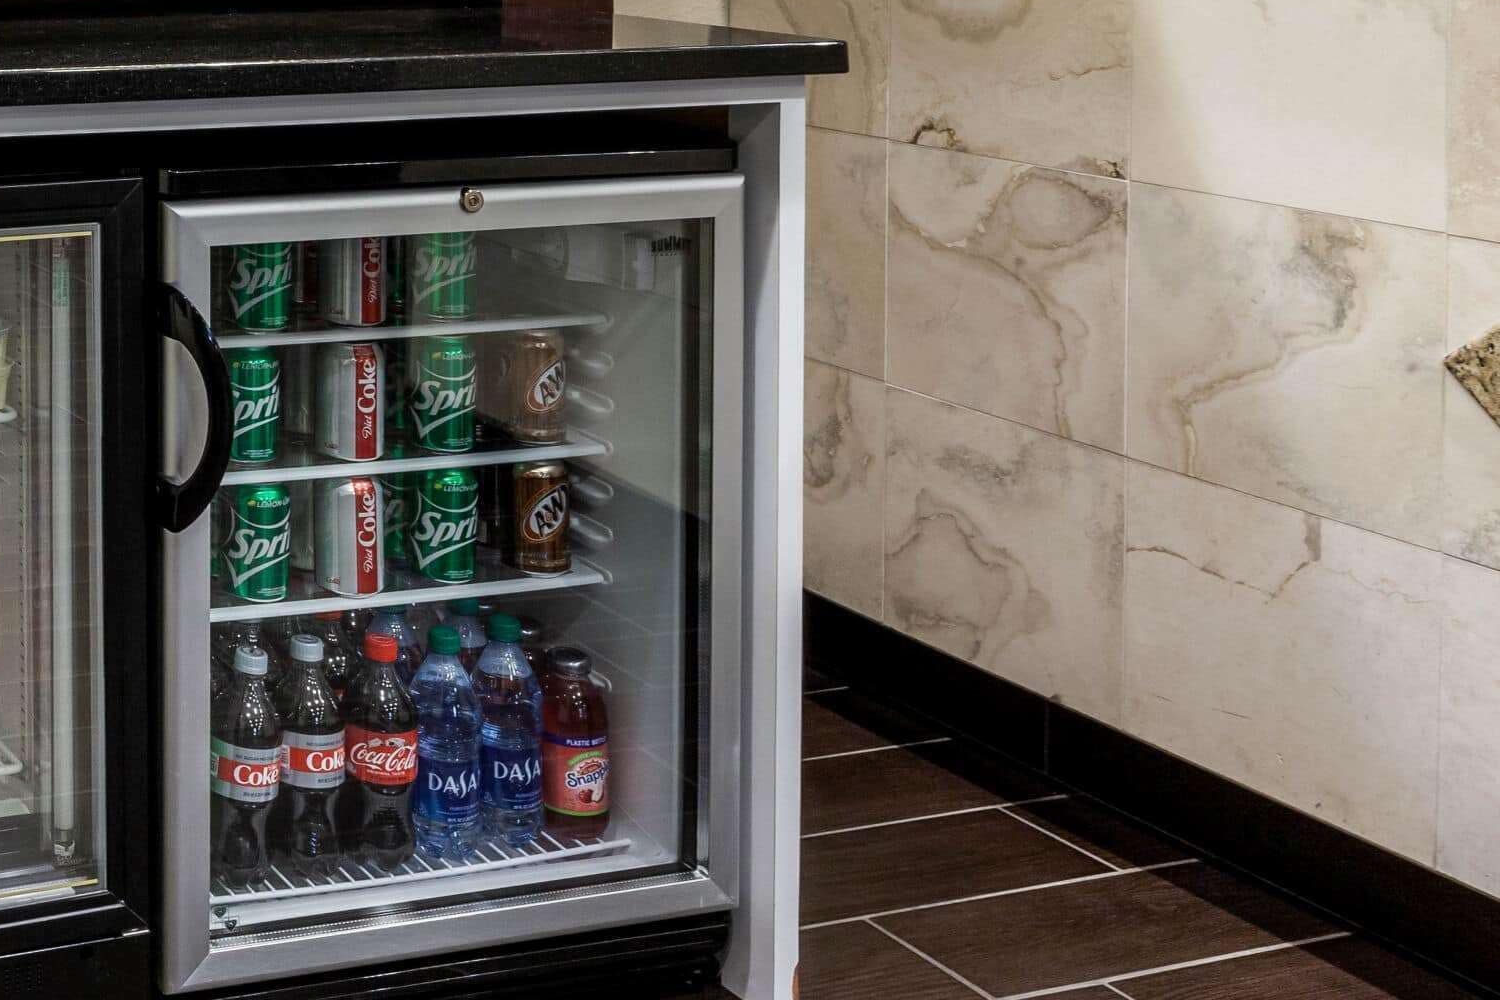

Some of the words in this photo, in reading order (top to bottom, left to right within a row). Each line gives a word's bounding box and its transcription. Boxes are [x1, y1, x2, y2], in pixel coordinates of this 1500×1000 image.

[230, 249, 292, 295] Spri
[357, 359, 376, 414] Coke
[414, 376, 477, 416] Spri
[363, 415, 373, 440] Diet
[358, 491, 376, 548] Coke
[414, 506, 477, 548] Spri
[228, 520, 291, 565] Spri
[363, 549, 374, 574] Diet
[350, 742, 417, 773] Coca-Cola
[566, 738, 591, 747] PLASTIC
[233, 764, 279, 786] Coke
[428, 769, 479, 799] DASA
[494, 758, 541, 786] DASA
